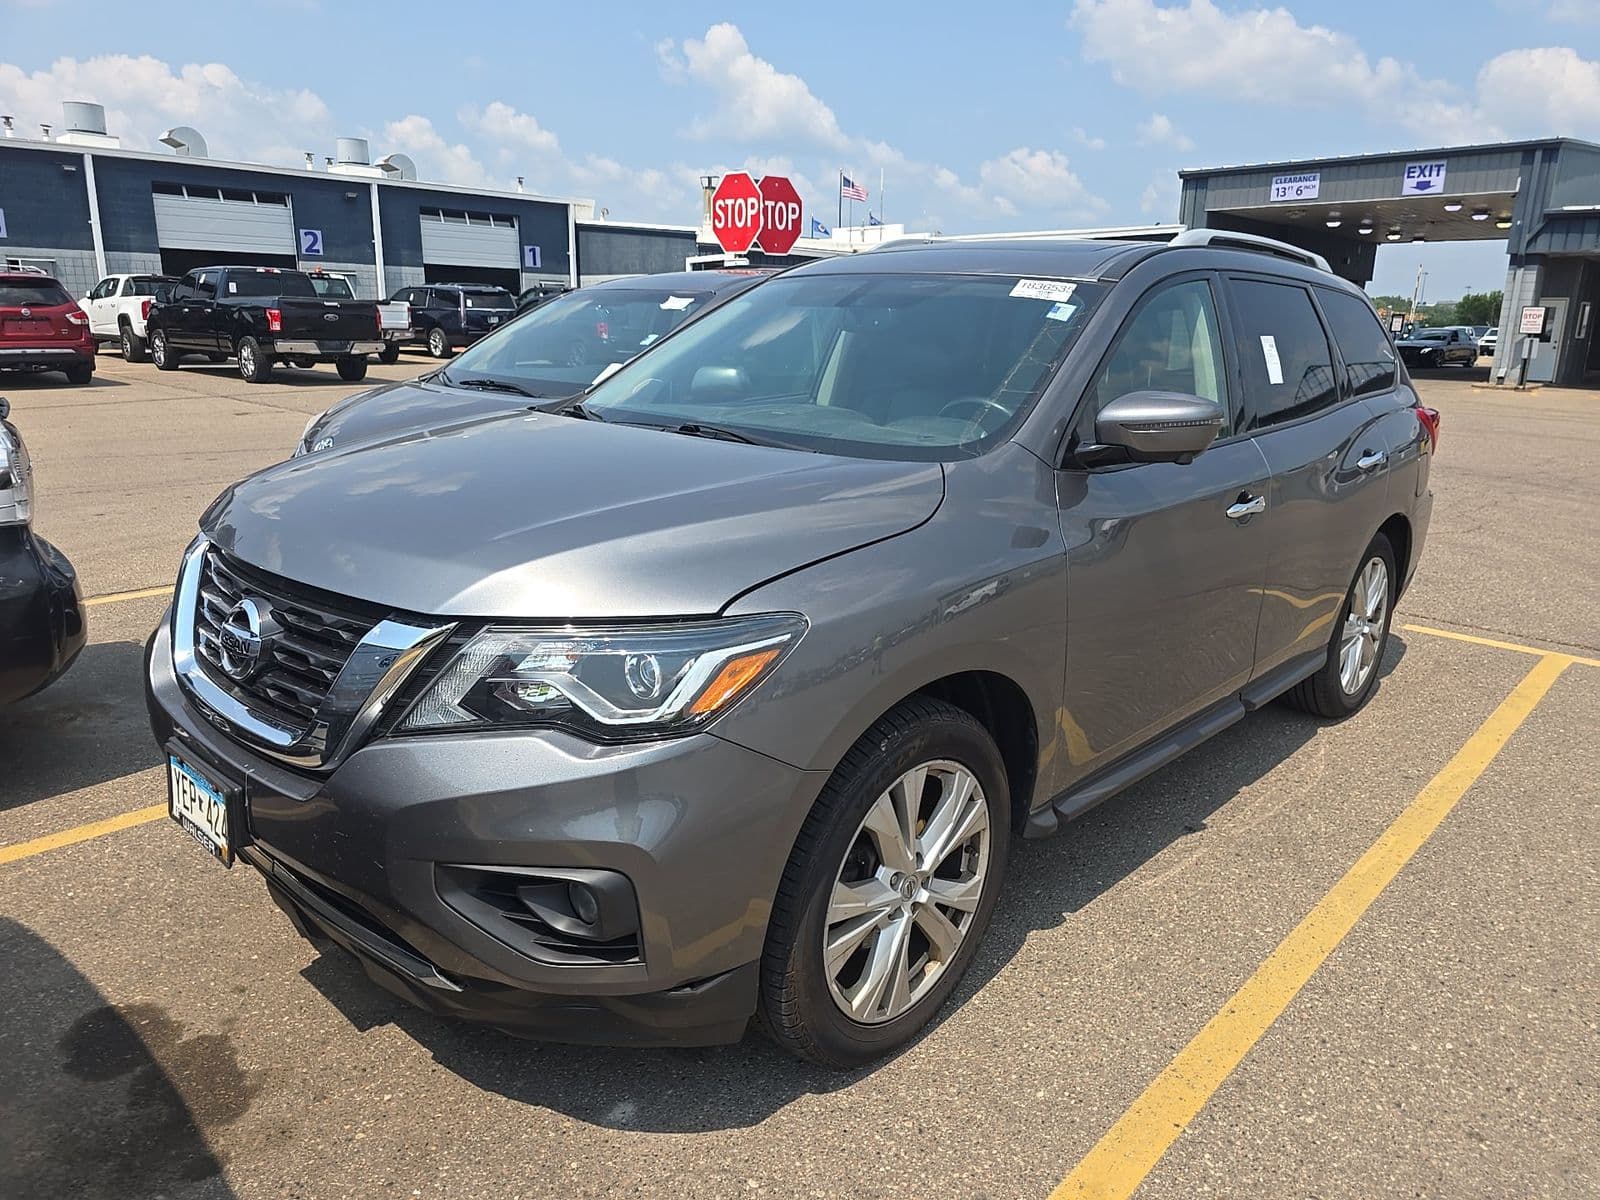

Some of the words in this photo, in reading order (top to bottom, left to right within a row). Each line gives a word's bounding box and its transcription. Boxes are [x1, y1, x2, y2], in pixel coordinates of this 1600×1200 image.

[1275, 175, 1317, 185] CLEARANCE
[1406, 164, 1444, 179] EXIT
[1276, 187, 1287, 198] 13
[1295, 185, 1303, 196] 6
[714, 197, 759, 228] STOP
[762, 200, 800, 230] TOP
[303, 231, 320, 253] 2
[529, 247, 537, 267] 1
[174, 768, 196, 815] YEP
[182, 816, 216, 856] WALSER
